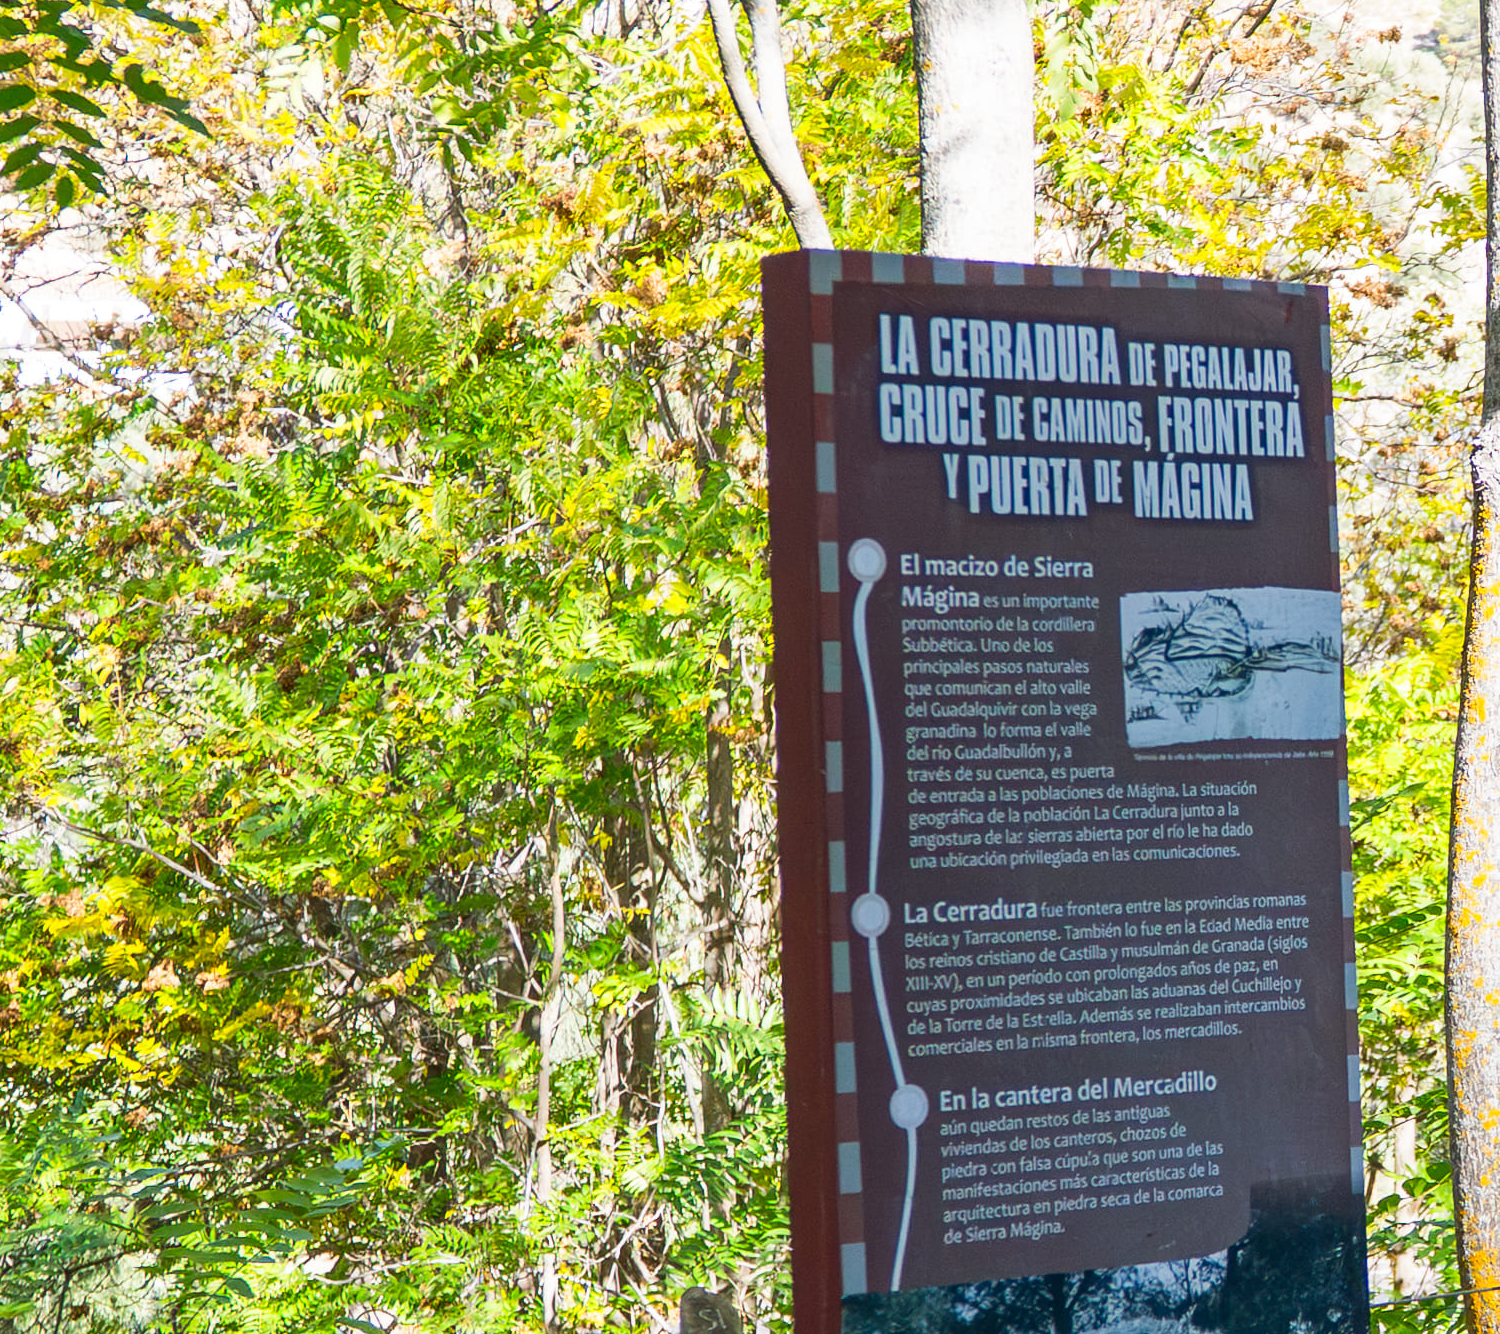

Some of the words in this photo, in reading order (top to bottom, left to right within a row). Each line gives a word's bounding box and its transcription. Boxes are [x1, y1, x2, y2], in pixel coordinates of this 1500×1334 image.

[879, 313, 920, 375] LA
[929, 317, 1121, 385] CERRADURA
[1128, 341, 1157, 386] DE
[1162, 343, 1300, 400] PEGALAJAR,
[879, 383, 987, 446] CRUCE
[995, 394, 1025, 442] DE
[1032, 396, 1152, 452] CAMINOS,
[1157, 395, 1305, 458] FRONTERA
[942, 453, 959, 500] Y
[967, 454, 1088, 517] PUERTA
[1094, 459, 1124, 504] DE
[1133, 452, 1254, 521] MÁGINA
[900, 552, 920, 576] El
[924, 554, 999, 577] macizo
[1003, 554, 1030, 578] de
[1034, 555, 1094, 578] Sierra
[901, 584, 980, 615] Mágina
[983, 596, 1000, 608] es
[1002, 596, 1021, 608] un
[1023, 593, 1100, 612] importante
[901, 616, 994, 635] promontorio
[995, 615, 1014, 632] de
[1016, 615, 1030, 632] la
[1032, 616, 1096, 632] cordillera
[902, 636, 978, 653] Subbética.
[980, 637, 1011, 653] Uno
[1012, 636, 1032, 653] de
[1033, 637, 1055, 653] los
[903, 658, 981, 679] principales
[982, 661, 1024, 678] pasos
[1026, 658, 1090, 674] naturales
[904, 683, 932, 700] que
[934, 680, 1012, 696] comunican
[1014, 679, 1027, 696] el
[1029, 678, 1057, 696] alto
[1059, 678, 1091, 695] valle
[905, 700, 928, 718] del
[930, 700, 1019, 721] Guadalquivir
[1020, 703, 1047, 717] con
[1049, 699, 1062, 716] la
[1063, 702, 1098, 721] vega
[905, 723, 977, 744] granadina
[983, 722, 997, 739] lo
[999, 721, 1043, 738] forma
[1044, 721, 1058, 737] el
[1060, 721, 1092, 737] valle
[906, 744, 930, 761] del
[954, 742, 1047, 760] Guadalbullón
[1063, 745, 1073, 759] a
[906, 766, 952, 783] través
[954, 765, 974, 782] de
[975, 769, 993, 782] su
[995, 767, 1049, 783] cuenca,
[1051, 766, 1068, 780] es
[1069, 765, 1115, 783] puerta
[904, 902, 928, 924] La
[933, 897, 1038, 923] Cerradura
[1040, 901, 1064, 918] fue
[1066, 900, 1123, 917] frontera
[1125, 900, 1162, 914] entre
[1164, 897, 1183, 912] las
[1185, 894, 1251, 915] provincias
[1252, 894, 1307, 909] romanas
[904, 954, 927, 970] los
[929, 952, 974, 968] reinos
[976, 949, 1036, 966] cristiano
[1038, 946, 1057, 963] de
[1059, 944, 1108, 962] Castilla
[1109, 947, 1119, 963] y
[1120, 939, 1190, 959] musulmán
[1192, 939, 1209, 955] de
[1211, 935, 1265, 954] Granada
[1267, 934, 1309, 955] (siglos
[940, 1090, 966, 1112] En
[971, 1086, 990, 1109] la
[994, 1085, 1073, 1108] cantera
[1077, 1077, 1108, 1101] del
[1113, 1070, 1218, 1099] Mercadillo
[939, 1119, 967, 1136] aún
[970, 1115, 1024, 1137] quedan
[1026, 1113, 1070, 1129] restos
[1071, 1109, 1090, 1126] de
[1091, 1107, 1112, 1124] las
[1113, 1104, 1171, 1125] antiguas
[940, 1137, 1007, 1158] viviendas
[1009, 1135, 1028, 1152] de
[1030, 1134, 1051, 1150] los
[1053, 1131, 1118, 1148] canteros,
[1119, 1126, 1168, 1143] chozos
[1169, 1121, 1187, 1139] de
[941, 1161, 988, 1180] piedra
[990, 1161, 1017, 1175] con
[1018, 1155, 1052, 1173] falsa
[1103, 1151, 1129, 1169] que
[1131, 1148, 1156, 1163] son
[1158, 1146, 1184, 1160] una
[1186, 1142, 1204, 1158] de
[1205, 1140, 1224, 1156] las
[942, 1178, 1058, 1201] manifestaciones
[1059, 1172, 1089, 1190] más
[1090, 1165, 1187, 1188] características
[1188, 1162, 1206, 1179] de
[1207, 1160, 1220, 1176] la
[943, 1203, 1031, 1225] arquitectura
[1033, 1201, 1051, 1214] en
[1053, 1193, 1098, 1217] piedra
[1100, 1193, 1131, 1208] seca
[1133, 1187, 1151, 1205] de
[1153, 1186, 1166, 1203] la
[1167, 1184, 1224, 1202] comarca
[943, 1228, 963, 1245] de
[965, 1225, 1007, 1243] Sierra
[1010, 1219, 1066, 1241] Mágina.
